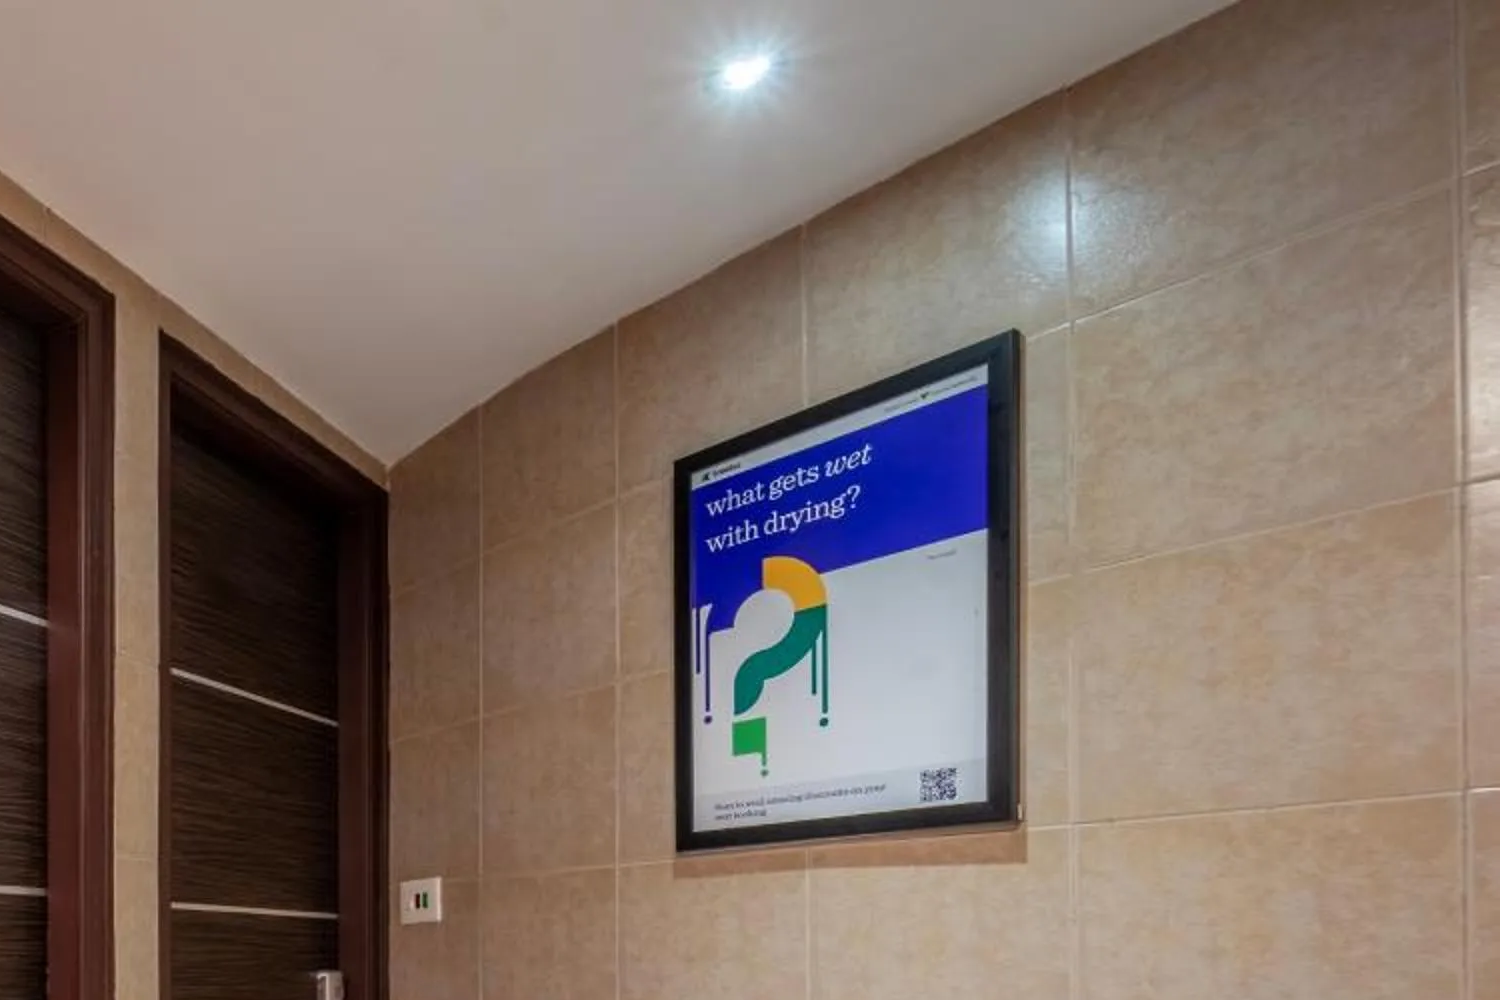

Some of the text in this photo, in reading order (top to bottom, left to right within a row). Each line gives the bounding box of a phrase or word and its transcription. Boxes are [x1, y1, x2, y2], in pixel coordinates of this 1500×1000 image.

[705, 482, 766, 517] what
[768, 464, 820, 501] gets
[824, 443, 873, 478] wet
[705, 484, 862, 553] with drying?
